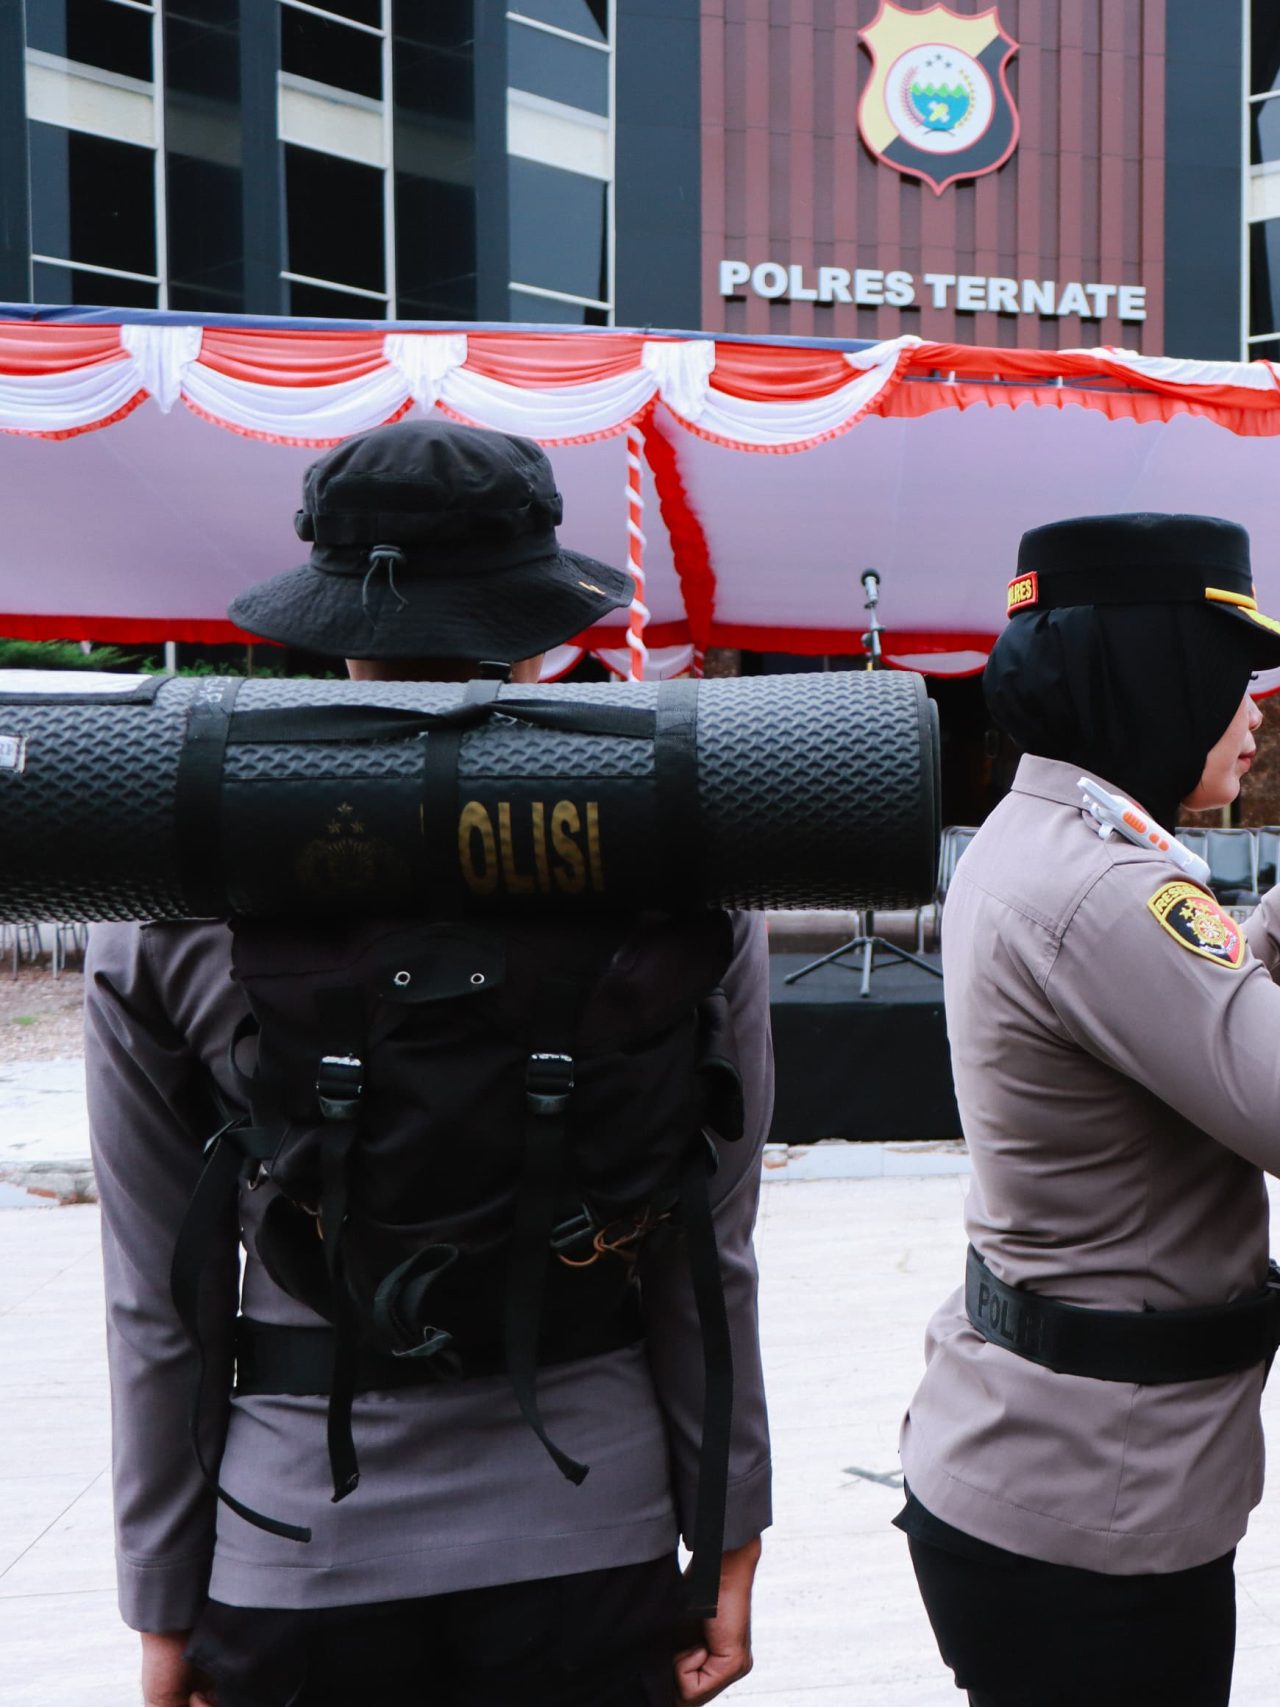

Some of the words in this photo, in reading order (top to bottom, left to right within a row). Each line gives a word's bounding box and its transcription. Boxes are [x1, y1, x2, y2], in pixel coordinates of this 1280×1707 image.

[719, 260, 914, 307] POLRES
[924, 272, 1147, 321] TERNATE
[419, 799, 606, 896] OLISI
